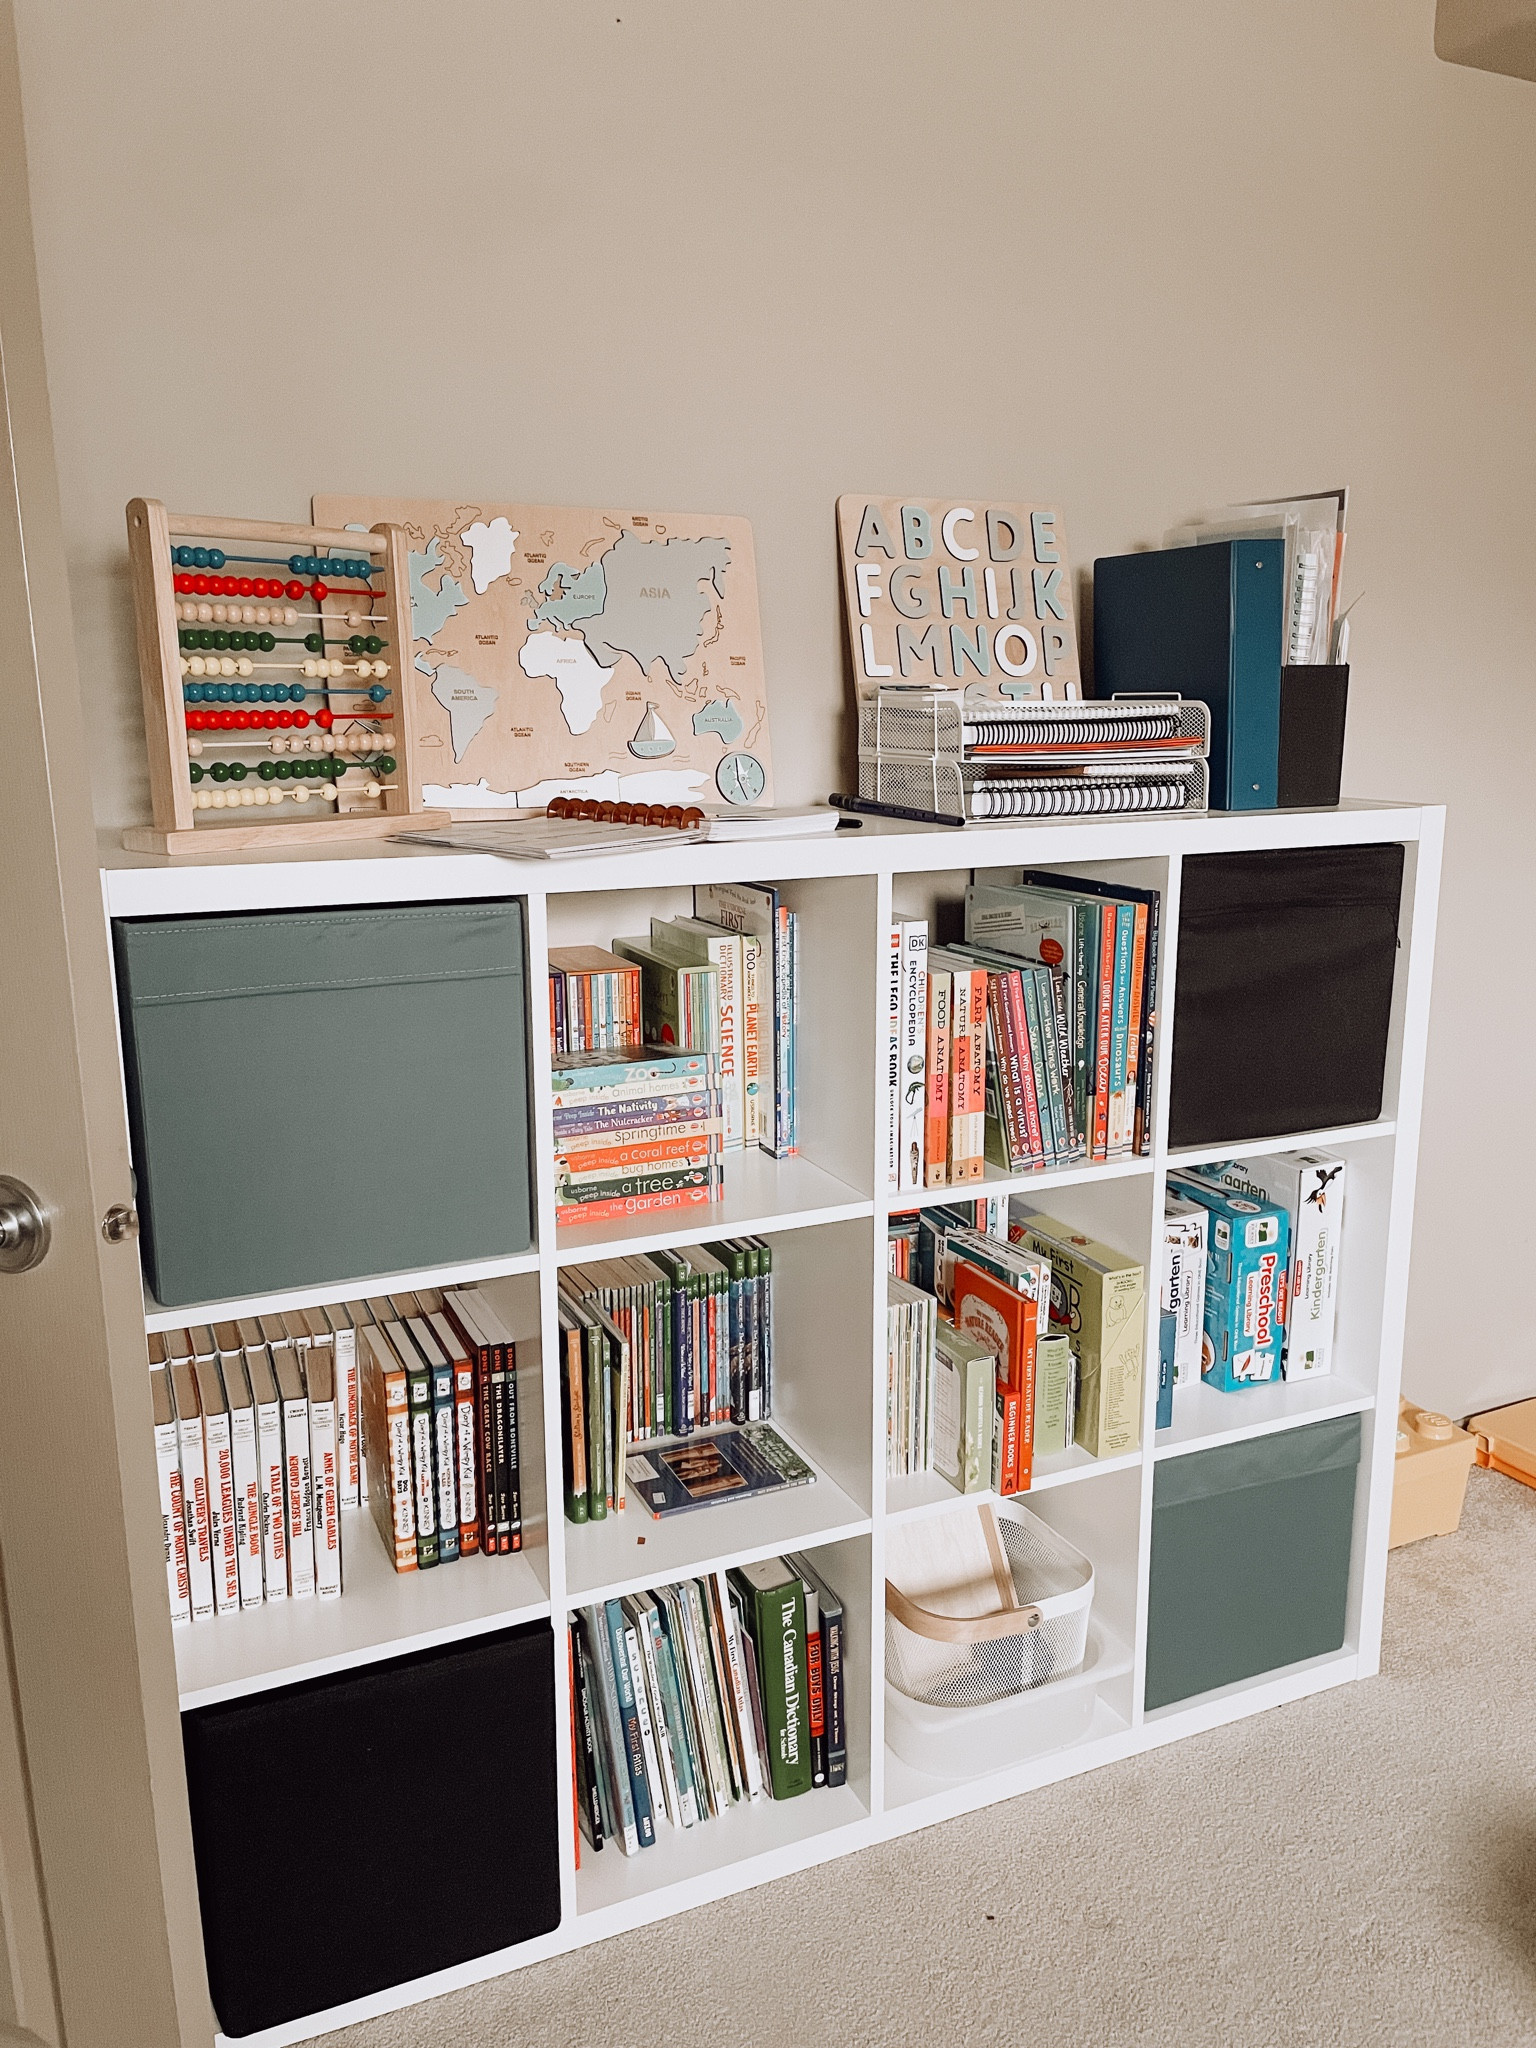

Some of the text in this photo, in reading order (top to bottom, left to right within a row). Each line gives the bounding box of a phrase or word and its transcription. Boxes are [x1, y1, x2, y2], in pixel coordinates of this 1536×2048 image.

[855, 504, 1062, 562] ABCDE
[639, 587, 671, 599] ASIA
[855, 564, 1067, 620] FGHIJK
[861, 624, 1073, 677] LMNOP
[721, 910, 744, 930] FIRST
[746, 948, 755, 970] 100
[912, 939, 924, 948] DK
[1076, 938, 1087, 1048] Lift-the-flap General Knowledge
[1117, 930, 1129, 1024] Questions Answers
[909, 960, 917, 1046] ENCYCLOPEDIA
[721, 1005, 734, 1078] SCIENCE
[747, 1004, 758, 1077] PLANET EARTH
[936, 989, 946, 1103] FOOD ANATOMY
[973, 987, 982, 1096] FARM ANATOMY
[1044, 1017, 1052, 1038] How
[1030, 1025, 1044, 1098] Seas Oceans
[1047, 1039, 1056, 1068] Things
[1114, 1033, 1124, 1086] Dinosaurs
[957, 1047, 965, 1110] ANATOMY
[1010, 1054, 1027, 1138] What virus?
[1050, 1069, 1060, 1095] Work
[595, 1116, 653, 1130] The Nutcracker
[598, 1100, 657, 1116] The Nativity
[615, 1123, 686, 1144] springtime
[622, 1159, 683, 1175] bug homes
[568, 1193, 680, 1220] peep inside the garden
[571, 1185, 597, 1194] usborne
[579, 1177, 674, 1202] peep inside a tree
[1033, 1240, 1074, 1274] My First
[1310, 1231, 1326, 1320] Kindergarten
[1246, 1276, 1254, 1307] Learning
[1257, 1255, 1275, 1344] Preschool
[1182, 1301, 1190, 1332] Learning
[1027, 1348, 1033, 1358] MY
[348, 1384, 356, 1427] HUNCHBACK
[508, 1383, 516, 1399] OUT
[349, 1428, 357, 1438] OF
[349, 1440, 357, 1463] NOTRE
[461, 1406, 472, 1479] Diary Wimpy Kid
[496, 1402, 504, 1464] DRAGONSLAYER
[1007, 1401, 1016, 1468] BEGINNER BOOKS
[271, 1471, 281, 1494] TALE
[289, 1455, 302, 1537] THE SECRET GARDEN
[350, 1466, 358, 1485] DAME
[186, 1500, 197, 1545] Jonathan Swift
[194, 1478, 209, 1562] GULLIVER'S TRAVELS
[212, 1511, 220, 1527] Jules
[237, 1498, 246, 1545] Rudyard Kipling
[247, 1482, 259, 1556] THE JUNGLE BOOK
[272, 1496, 282, 1507] OF
[272, 1509, 283, 1529] TWO
[324, 1452, 336, 1550] ANNE OF GREEN GABLES
[465, 1492, 474, 1517] KINNEY
[170, 1470, 188, 1599] THE COUNT OF MONTE CRISTO
[218, 1449, 237, 1598] 20,000 LEAGUES UNDER THE SEA
[274, 1532, 284, 1559] CITIES
[728, 1635, 734, 1646] My
[729, 1647, 737, 1662] First
[615, 1627, 633, 1703] Discovering Our World
[732, 1664, 741, 1694] Canadian
[781, 1597, 800, 1765] The Canadian Dictionary
[809, 1642, 823, 1722] FOR BOYS ONLY
[627, 1717, 643, 1776] My First Atlas
